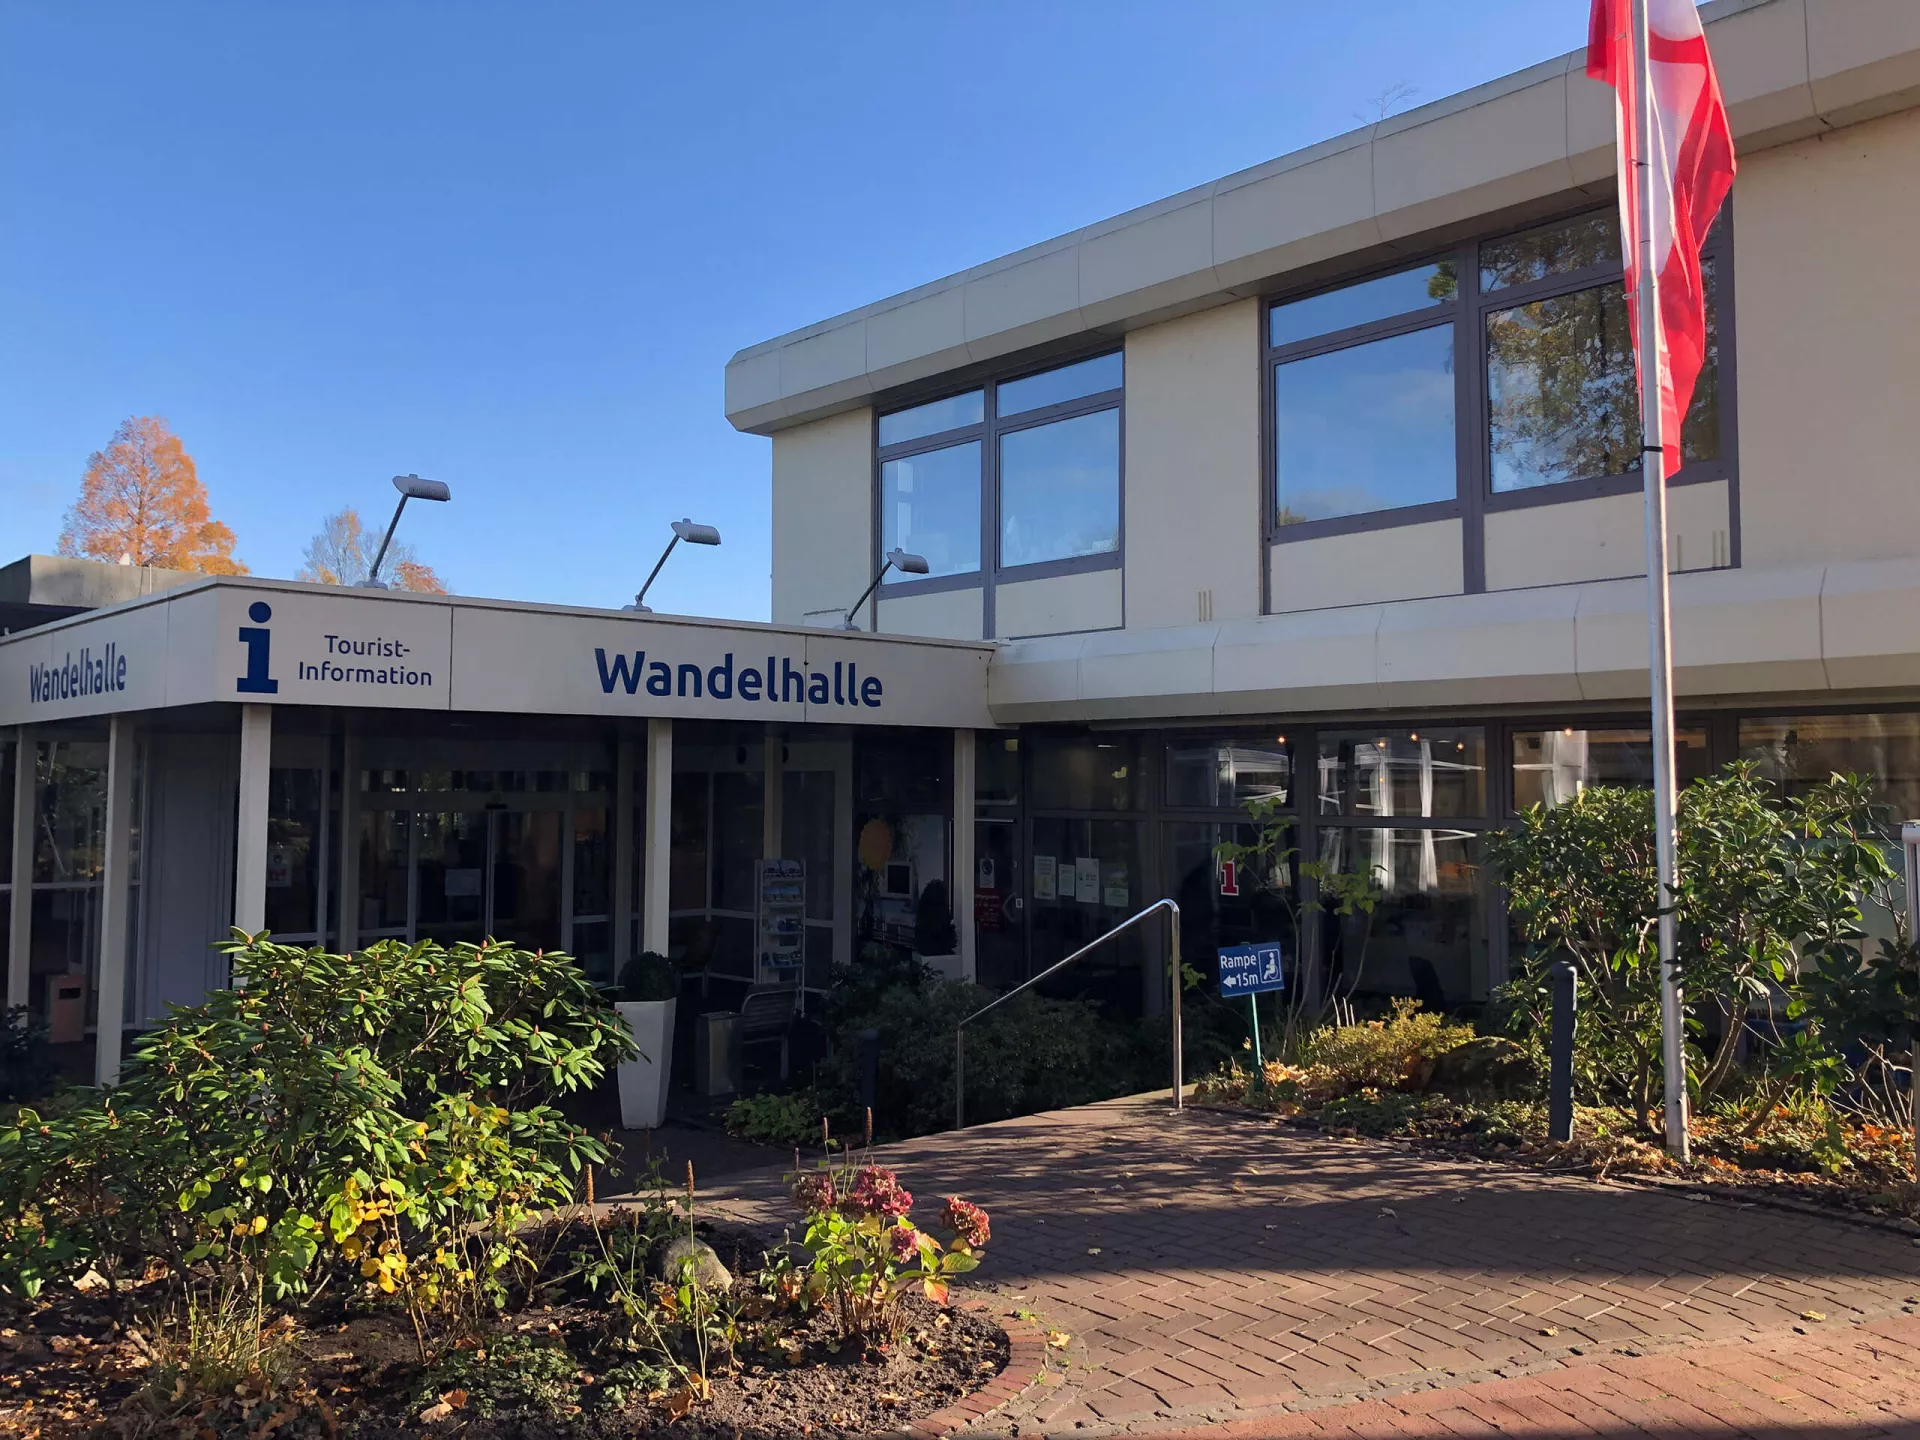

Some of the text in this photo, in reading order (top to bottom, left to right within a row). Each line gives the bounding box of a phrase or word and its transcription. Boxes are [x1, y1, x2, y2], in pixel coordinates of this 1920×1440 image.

[237, 601, 279, 694] i
[324, 634, 411, 658] Tourist-
[29, 642, 127, 704] Wandelhalle
[298, 661, 433, 686] Information
[593, 647, 883, 708] Wandelhalle
[1220, 954, 1257, 969] Rampe
[1235, 972, 1259, 988] 15m
